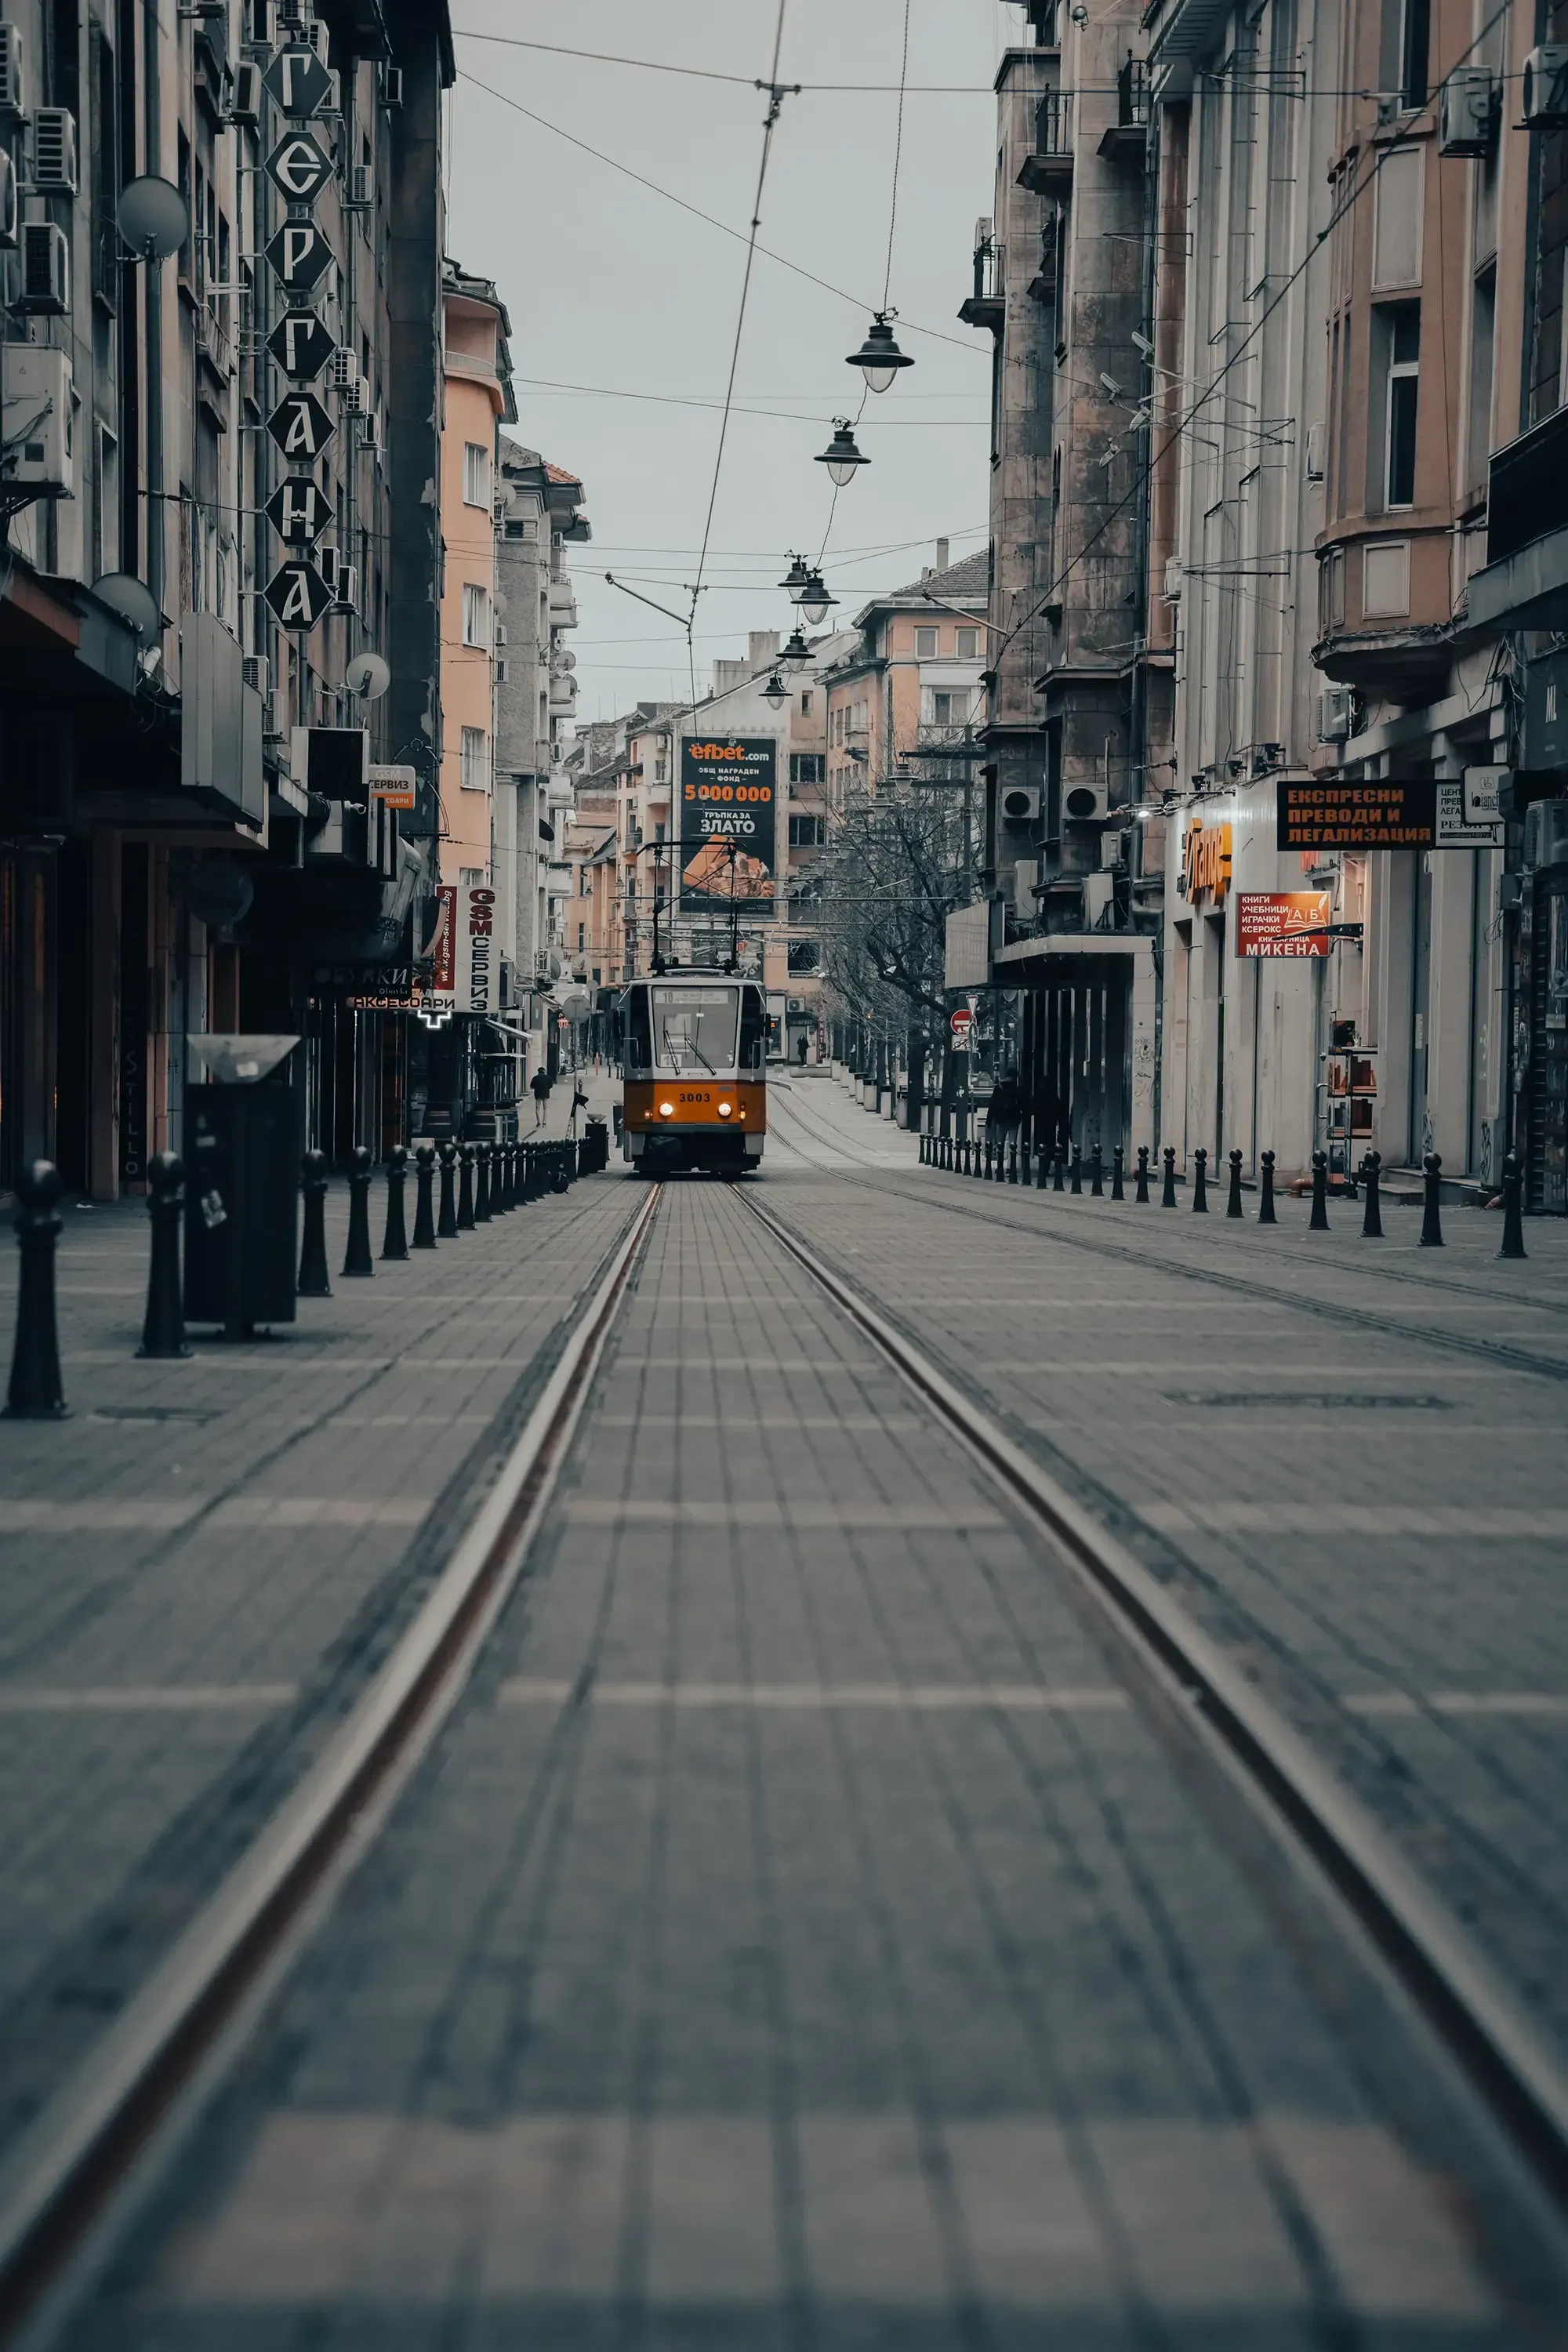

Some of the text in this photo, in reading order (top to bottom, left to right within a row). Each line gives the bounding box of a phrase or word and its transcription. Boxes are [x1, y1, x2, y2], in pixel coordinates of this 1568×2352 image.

[276, 53, 319, 622] ГЕРГАНА
[688, 742, 769, 760] efbet.com
[1287, 789, 1404, 804] ЕКСПРЕСНИ
[1287, 808, 1399, 824] ПРЕВОДИ И
[700, 819, 756, 833] ЗЛАТО
[1287, 827, 1432, 843] ЛЕГАЛИЗАЦИЯ
[1242, 906, 1289, 914] УЧЕБНИЦИ
[469, 889, 495, 1011] GSM СЕРВИЗ
[1246, 943, 1320, 956] МИКЕНА
[663, 992, 673, 1004] 10
[679, 1093, 710, 1102] 3003
